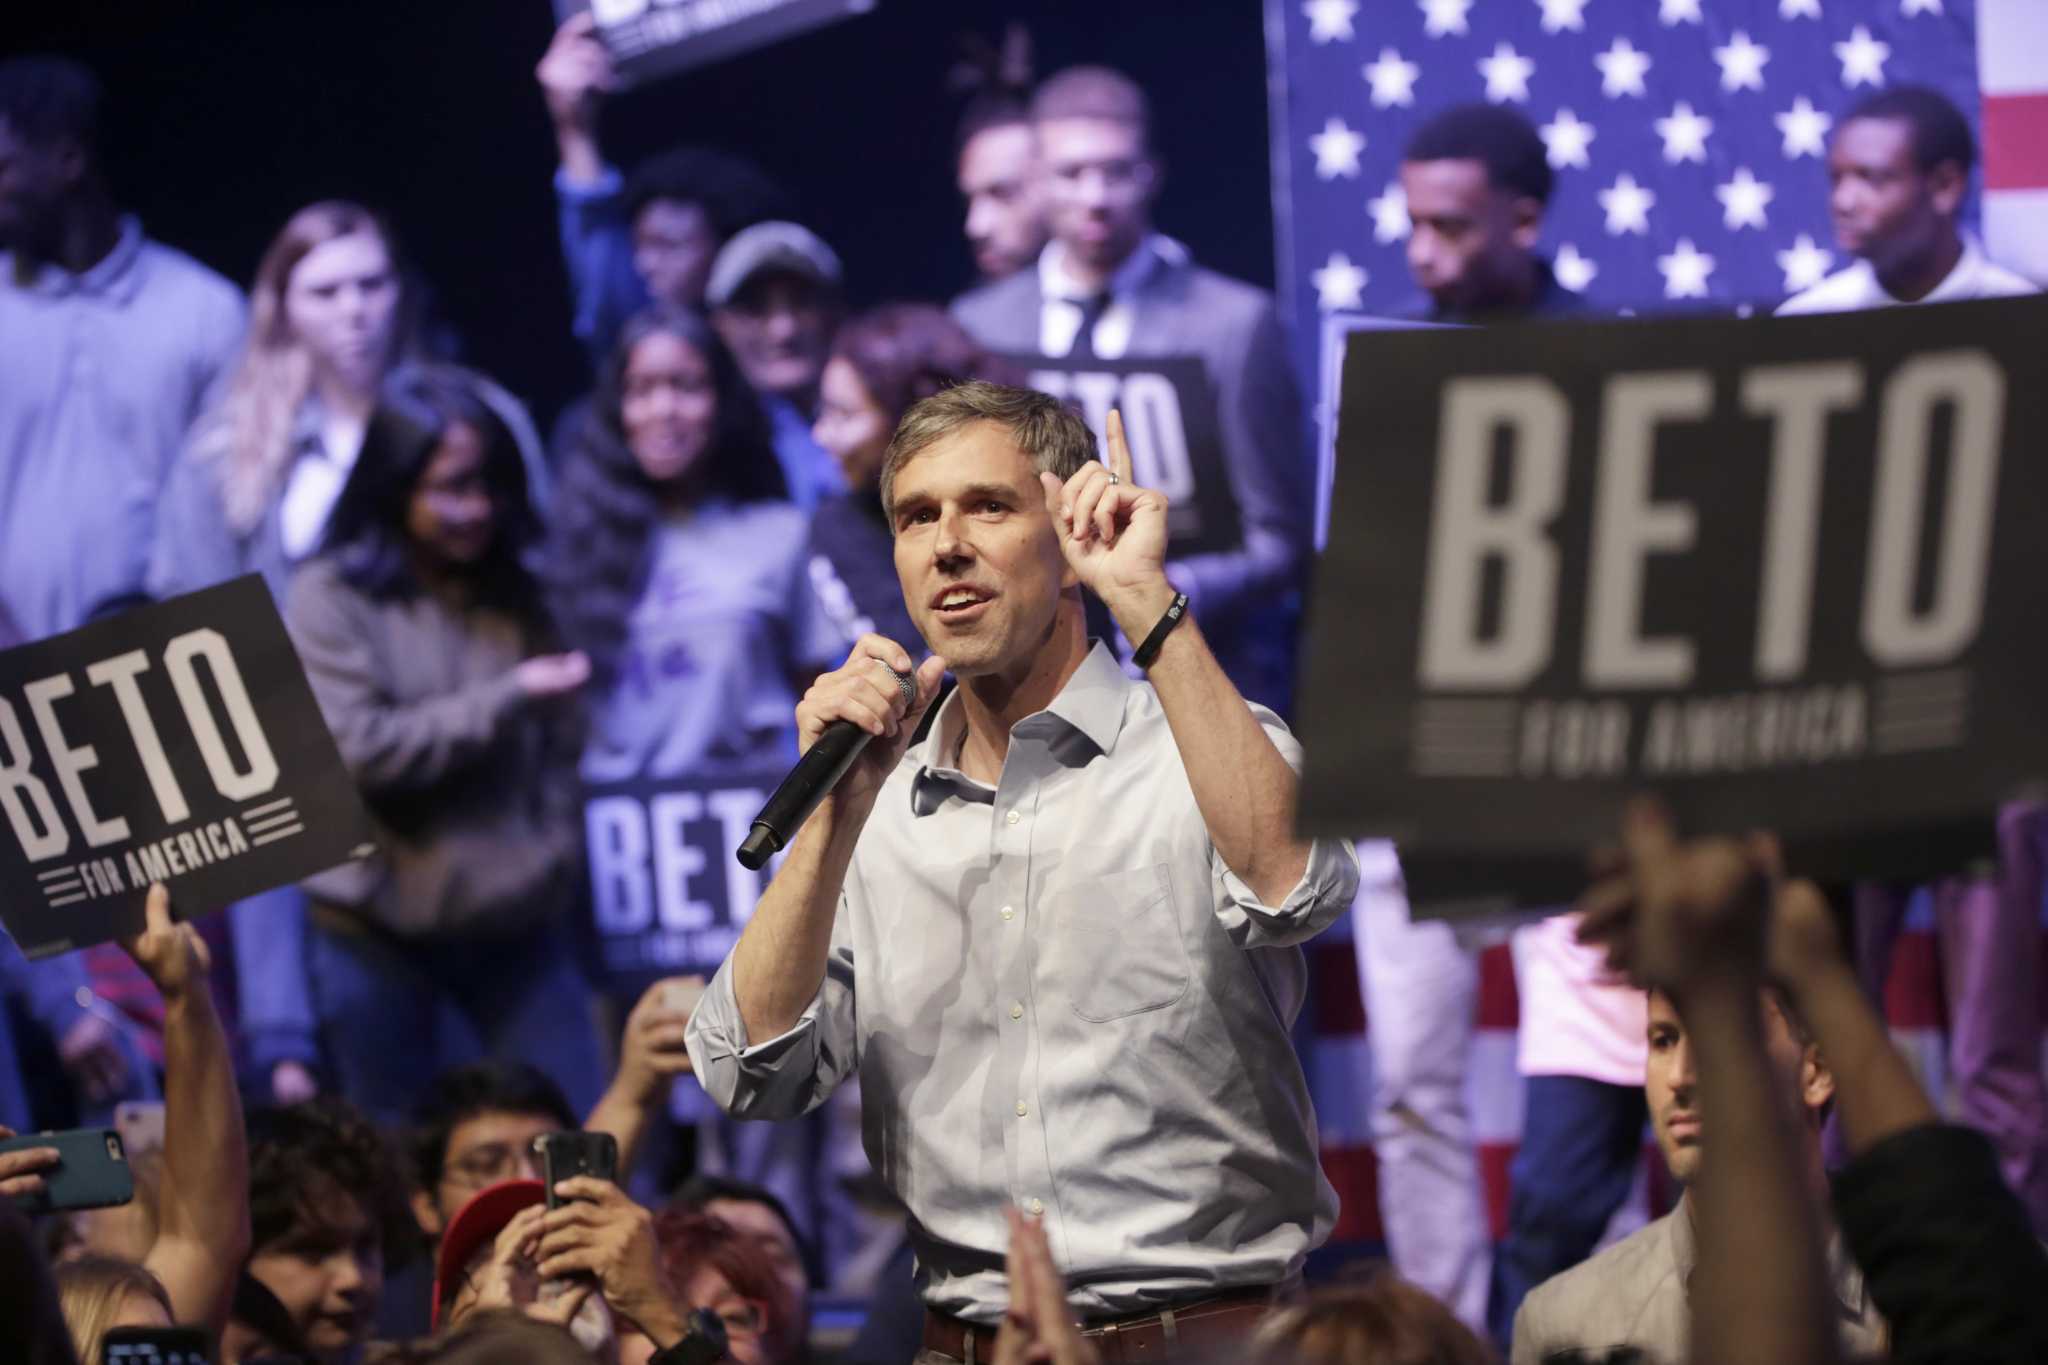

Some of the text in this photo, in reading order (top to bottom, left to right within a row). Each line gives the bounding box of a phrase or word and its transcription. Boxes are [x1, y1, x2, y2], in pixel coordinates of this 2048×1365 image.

[1418, 350, 2006, 690] BETO
[0, 627, 281, 863] BETO
[1519, 698, 1632, 779] FOR
[78, 816, 249, 899] FOR AMERICA
[585, 787, 797, 935] BET
